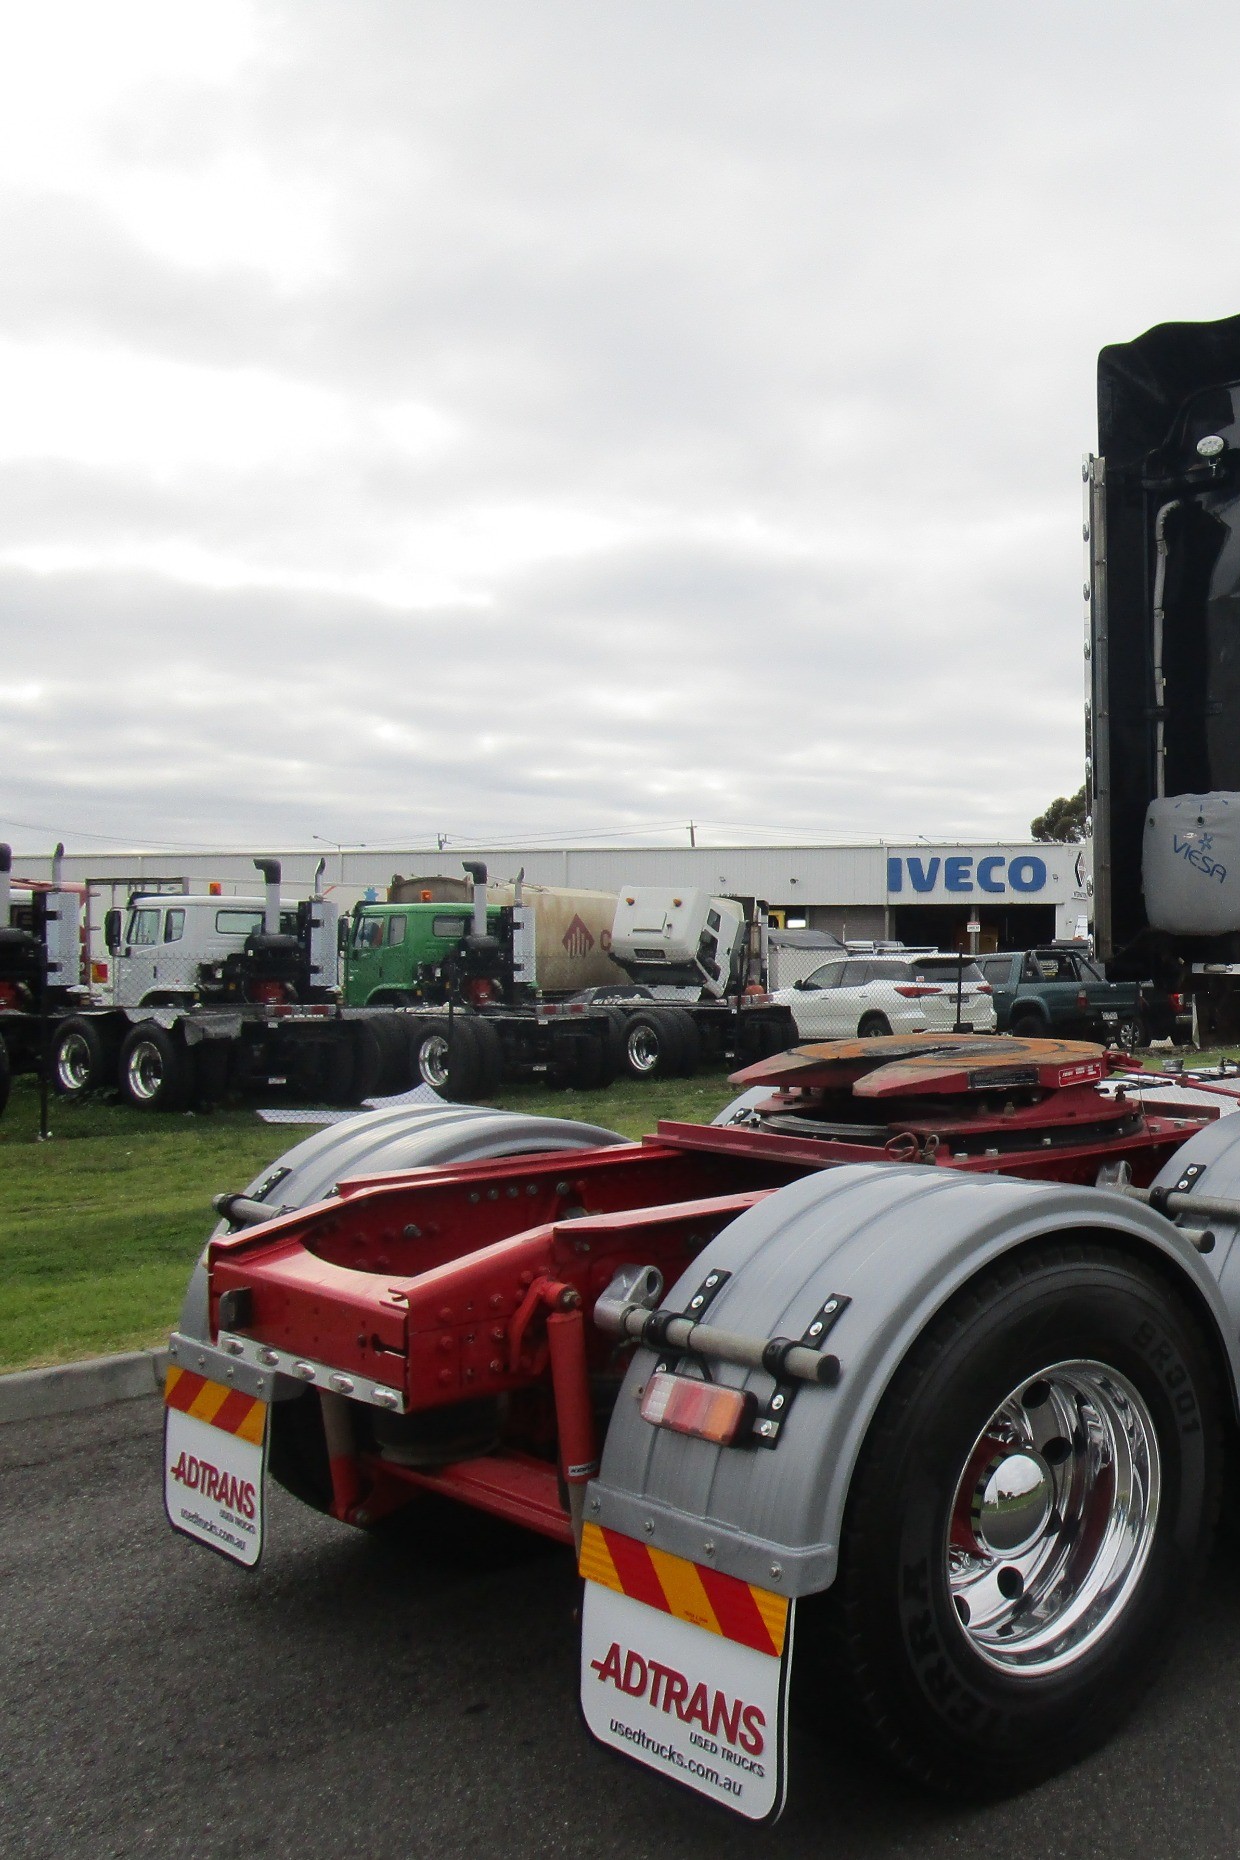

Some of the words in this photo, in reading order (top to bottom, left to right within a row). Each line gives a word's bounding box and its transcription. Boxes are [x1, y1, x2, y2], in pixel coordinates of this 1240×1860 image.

[887, 856, 1047, 893] IVECO
[1173, 834, 1228, 884] VIESA
[170, 1451, 256, 1519] ADTRANS
[590, 1642, 767, 1757] ADTRANS
[609, 1717, 744, 1798] usedtrucks.com.au
[689, 1732, 719, 1756] USED
[720, 1746, 766, 1778] TRUCKS
